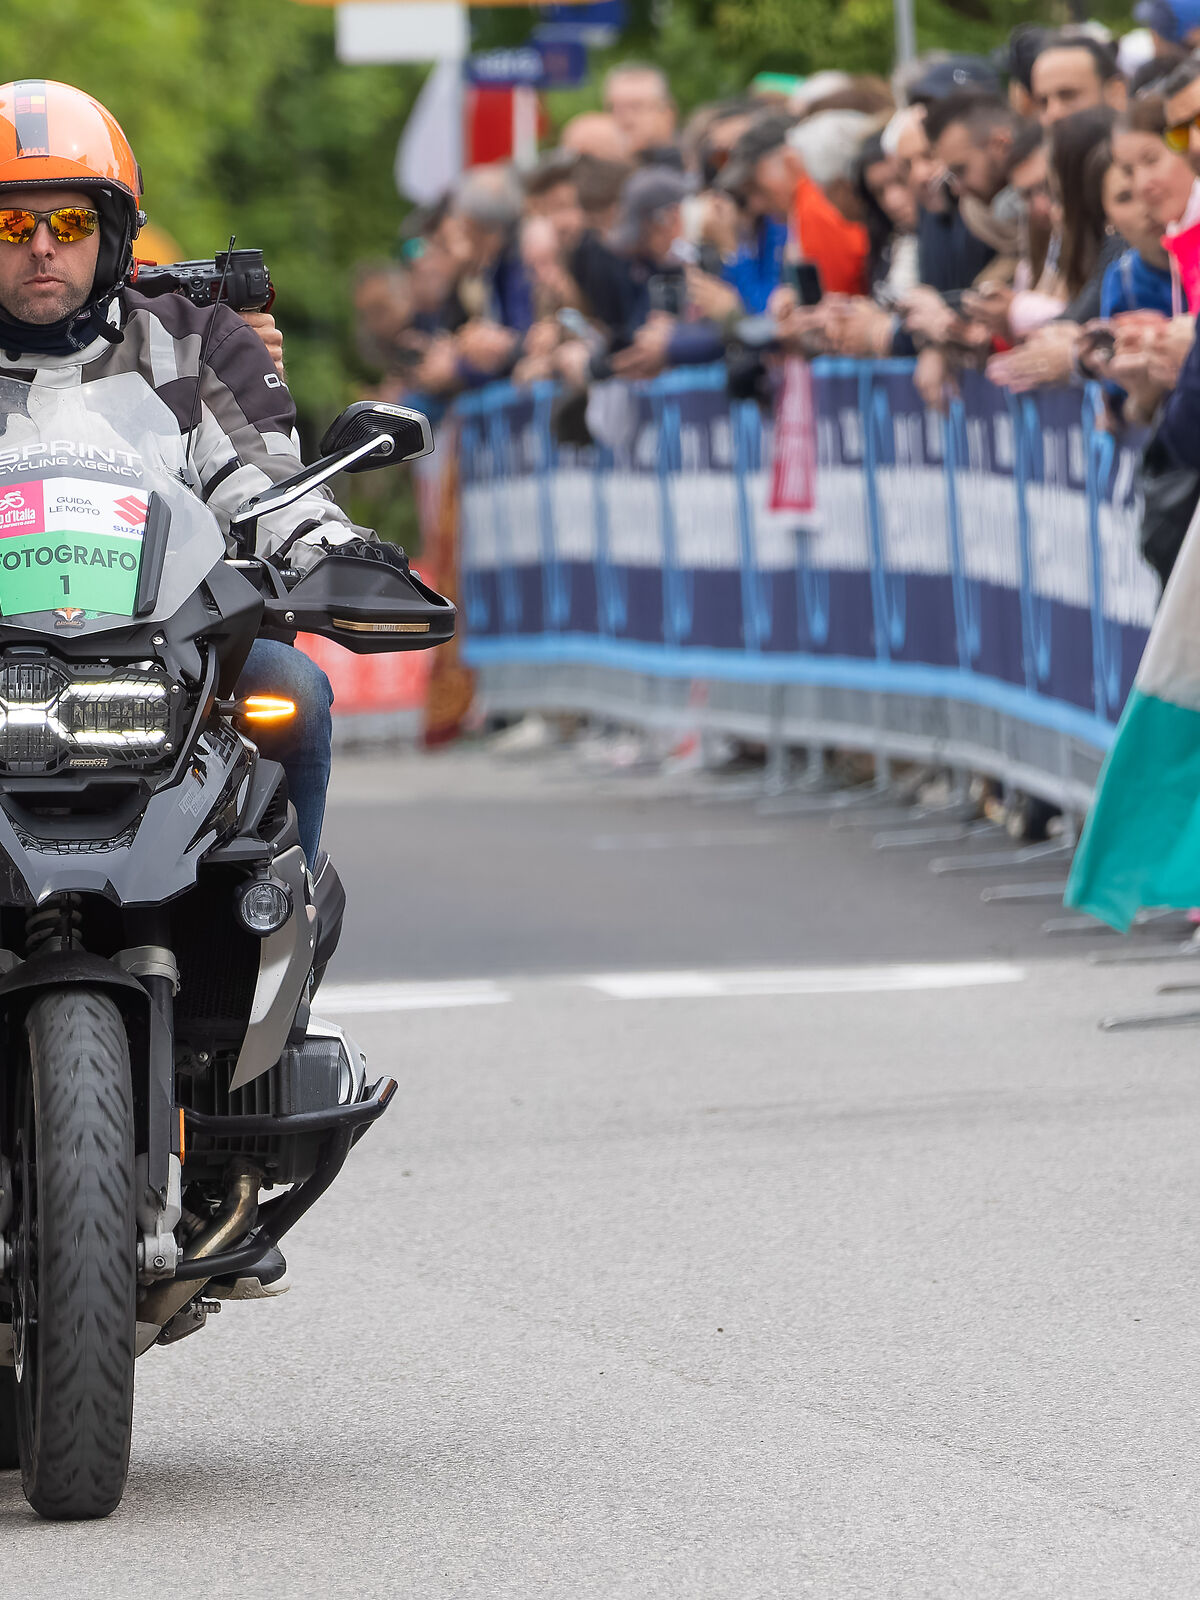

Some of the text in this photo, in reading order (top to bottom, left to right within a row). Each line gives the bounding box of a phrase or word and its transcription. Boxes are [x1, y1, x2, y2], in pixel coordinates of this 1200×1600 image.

[73, 459, 144, 479] AGENCY
[56, 496, 93, 506] GUIDA
[49, 506, 101, 517] LE MOTO
[113, 524, 144, 536] SUZU
[59, 575, 70, 595] 1
